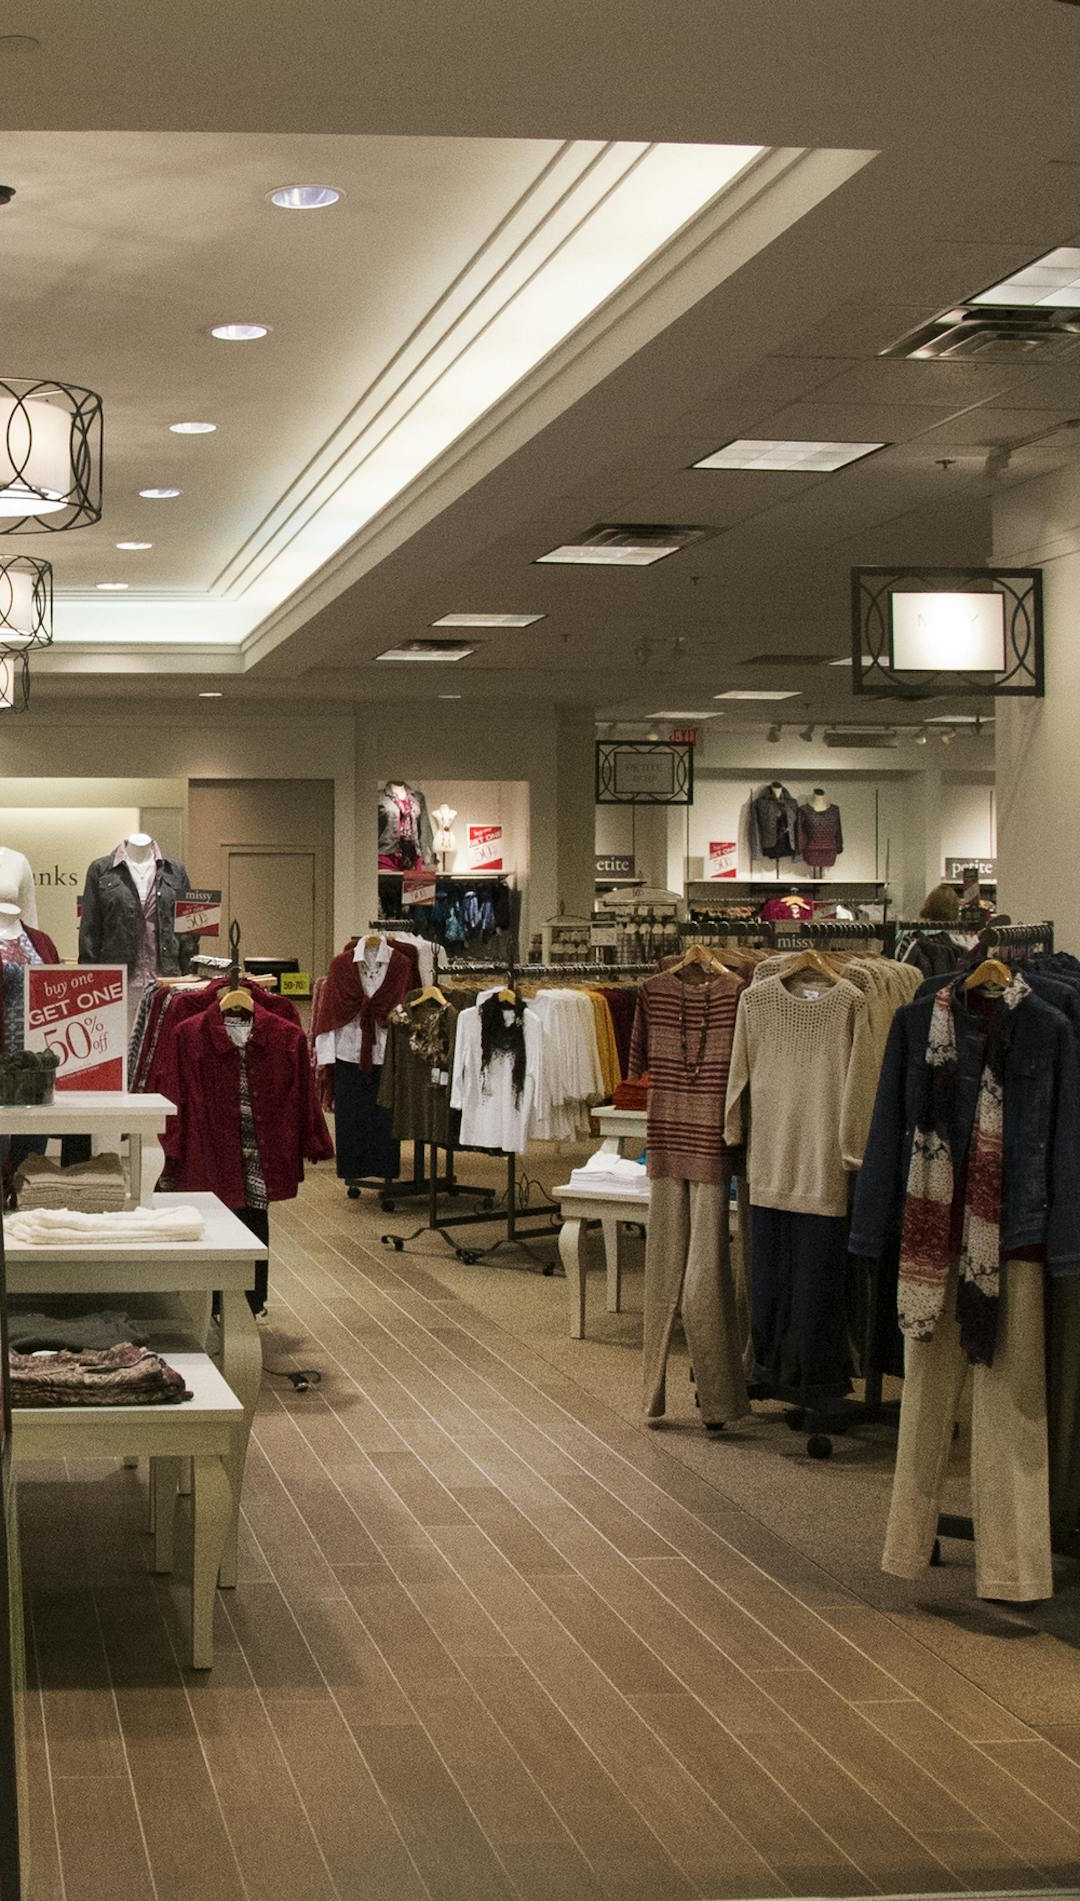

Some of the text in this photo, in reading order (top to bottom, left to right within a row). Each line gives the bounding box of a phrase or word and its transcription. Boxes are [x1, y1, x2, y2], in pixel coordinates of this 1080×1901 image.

[596, 857, 630, 871] etite
[33, 865, 78, 886] nks
[186, 891, 213, 903] missy
[43, 973, 94, 998] buy one
[29, 982, 123, 1025] GET ONE
[93, 1031, 109, 1054] off
